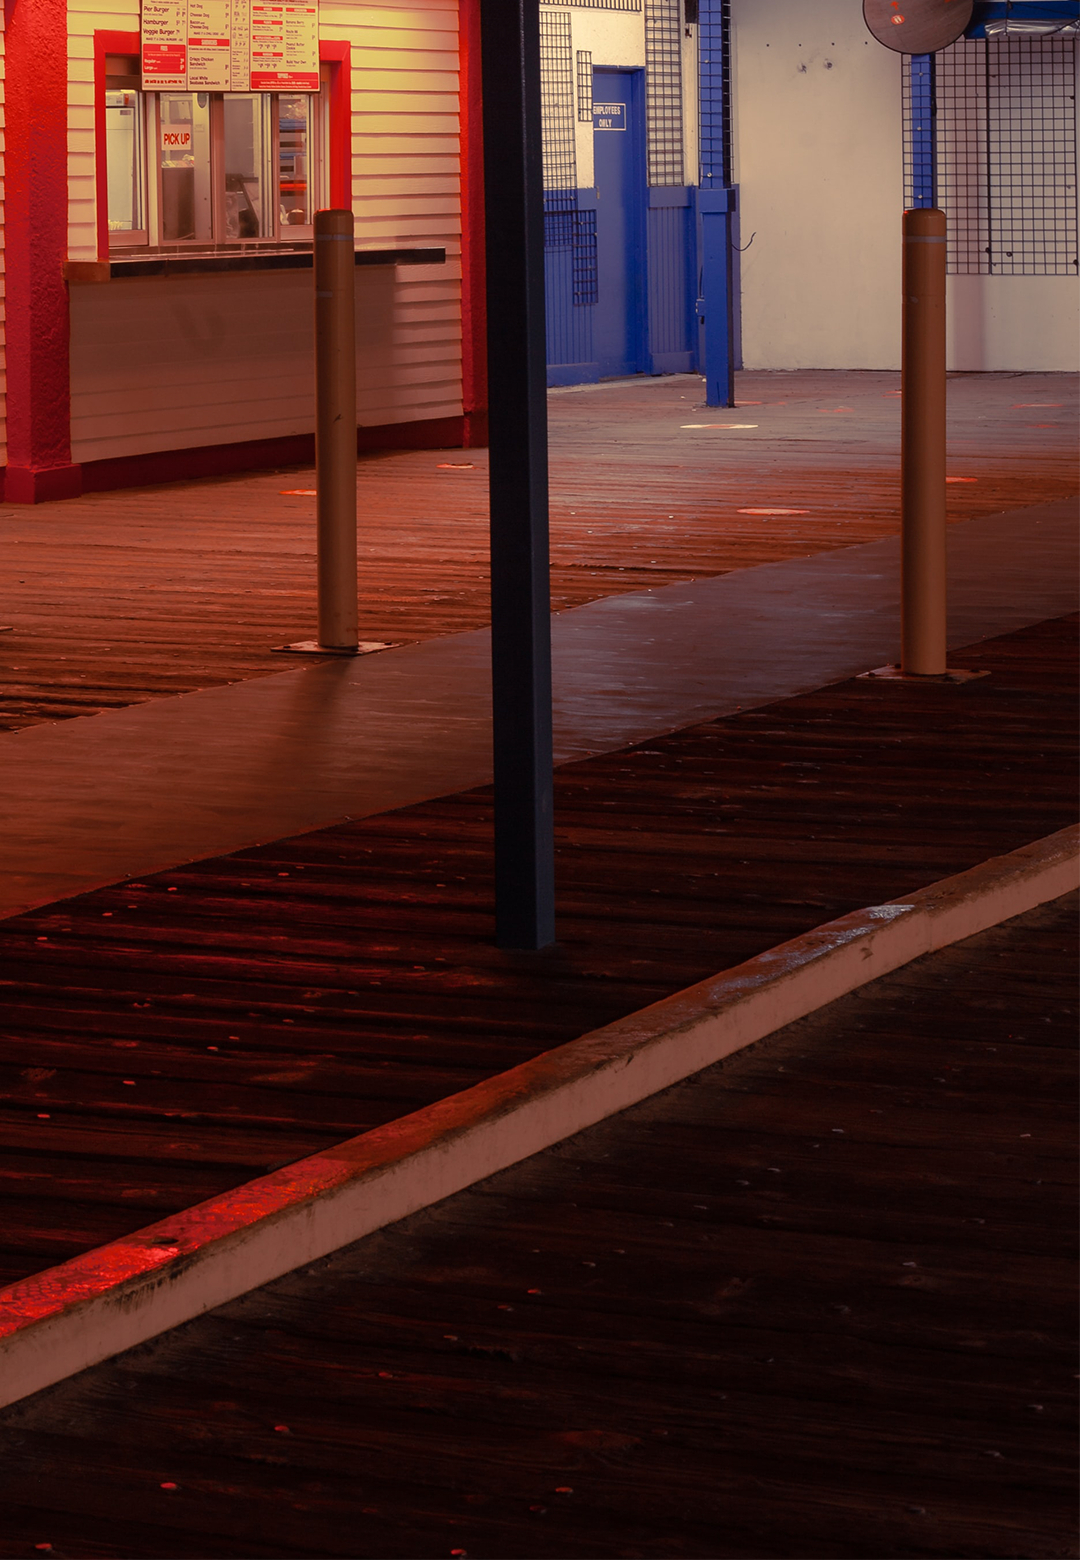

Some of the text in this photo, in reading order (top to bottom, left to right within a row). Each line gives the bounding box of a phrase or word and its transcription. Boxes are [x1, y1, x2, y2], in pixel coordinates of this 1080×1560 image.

[593, 106, 621, 115] EMPLOYEES
[599, 118, 612, 128] ONLY
[163, 132, 191, 146] PICK UP
